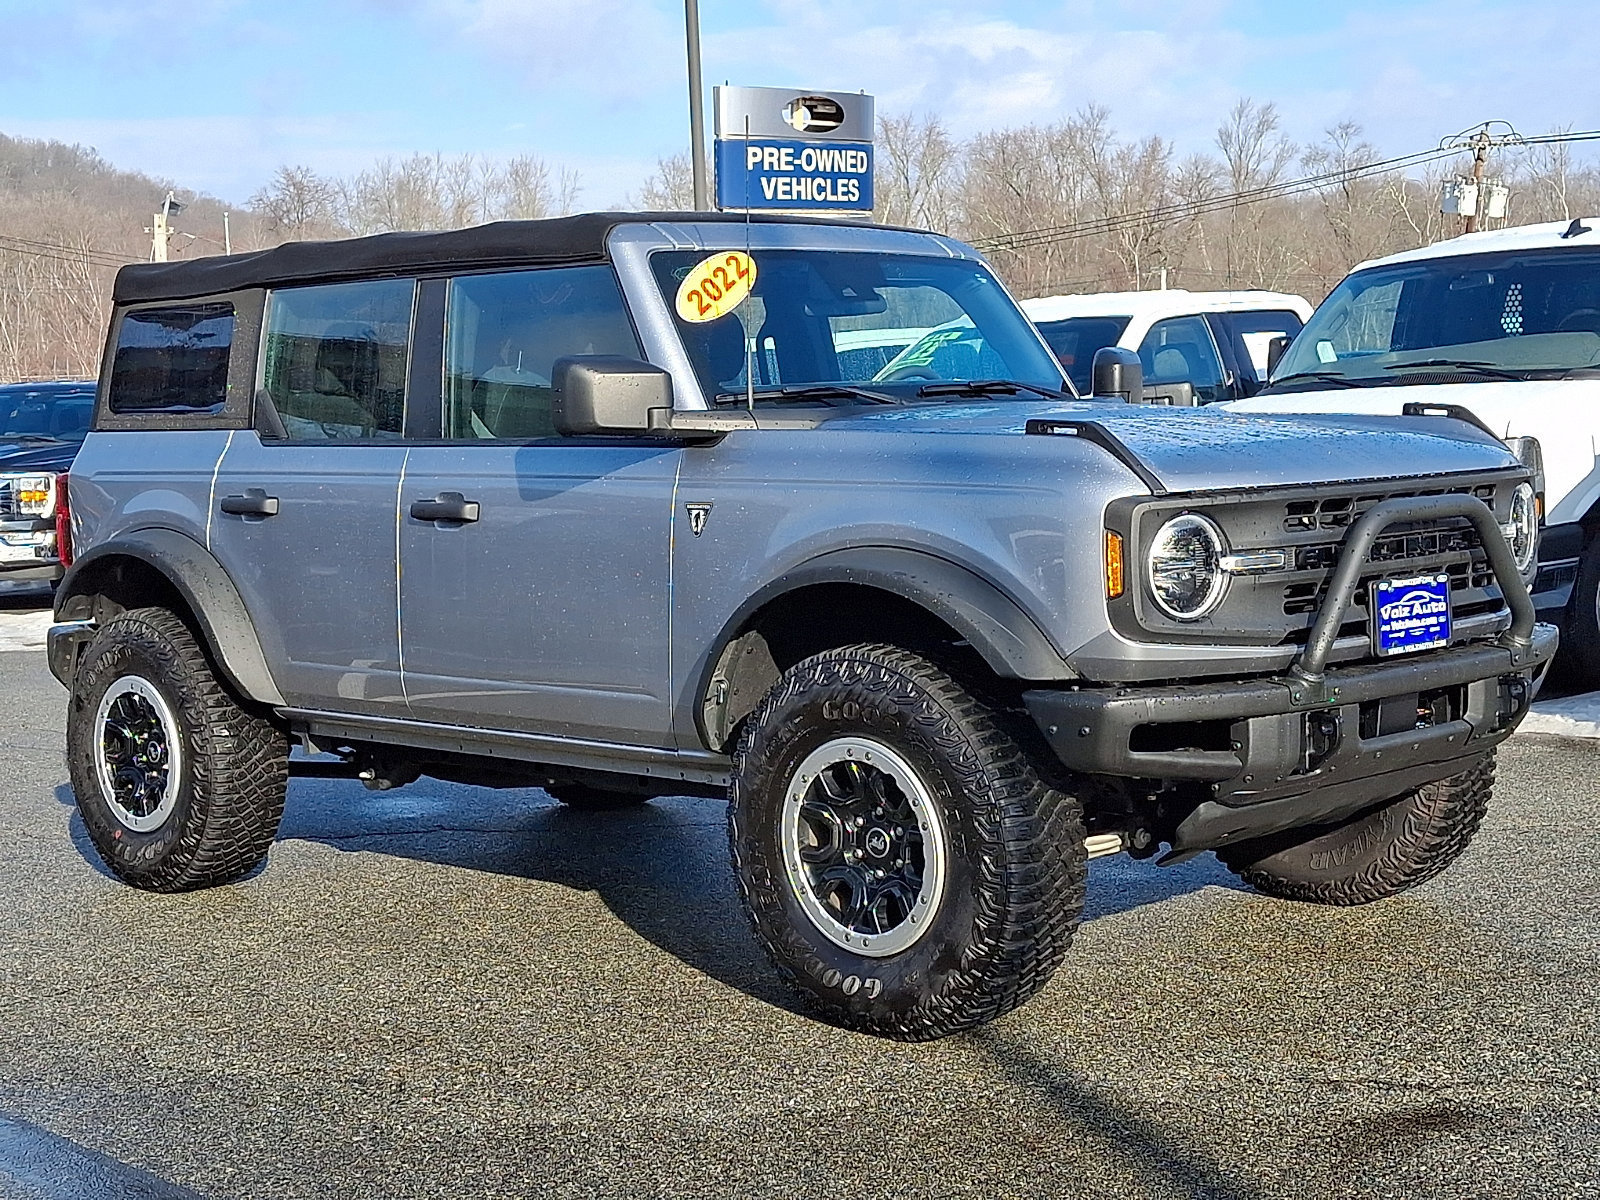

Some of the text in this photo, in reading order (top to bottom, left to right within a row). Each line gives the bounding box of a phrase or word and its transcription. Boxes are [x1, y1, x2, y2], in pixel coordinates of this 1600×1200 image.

[746, 146, 868, 174] PRE-OWNED
[760, 177, 860, 202] VEHICLES
[687, 255, 749, 316] 2022
[1380, 601, 1447, 620] Volz Auto
